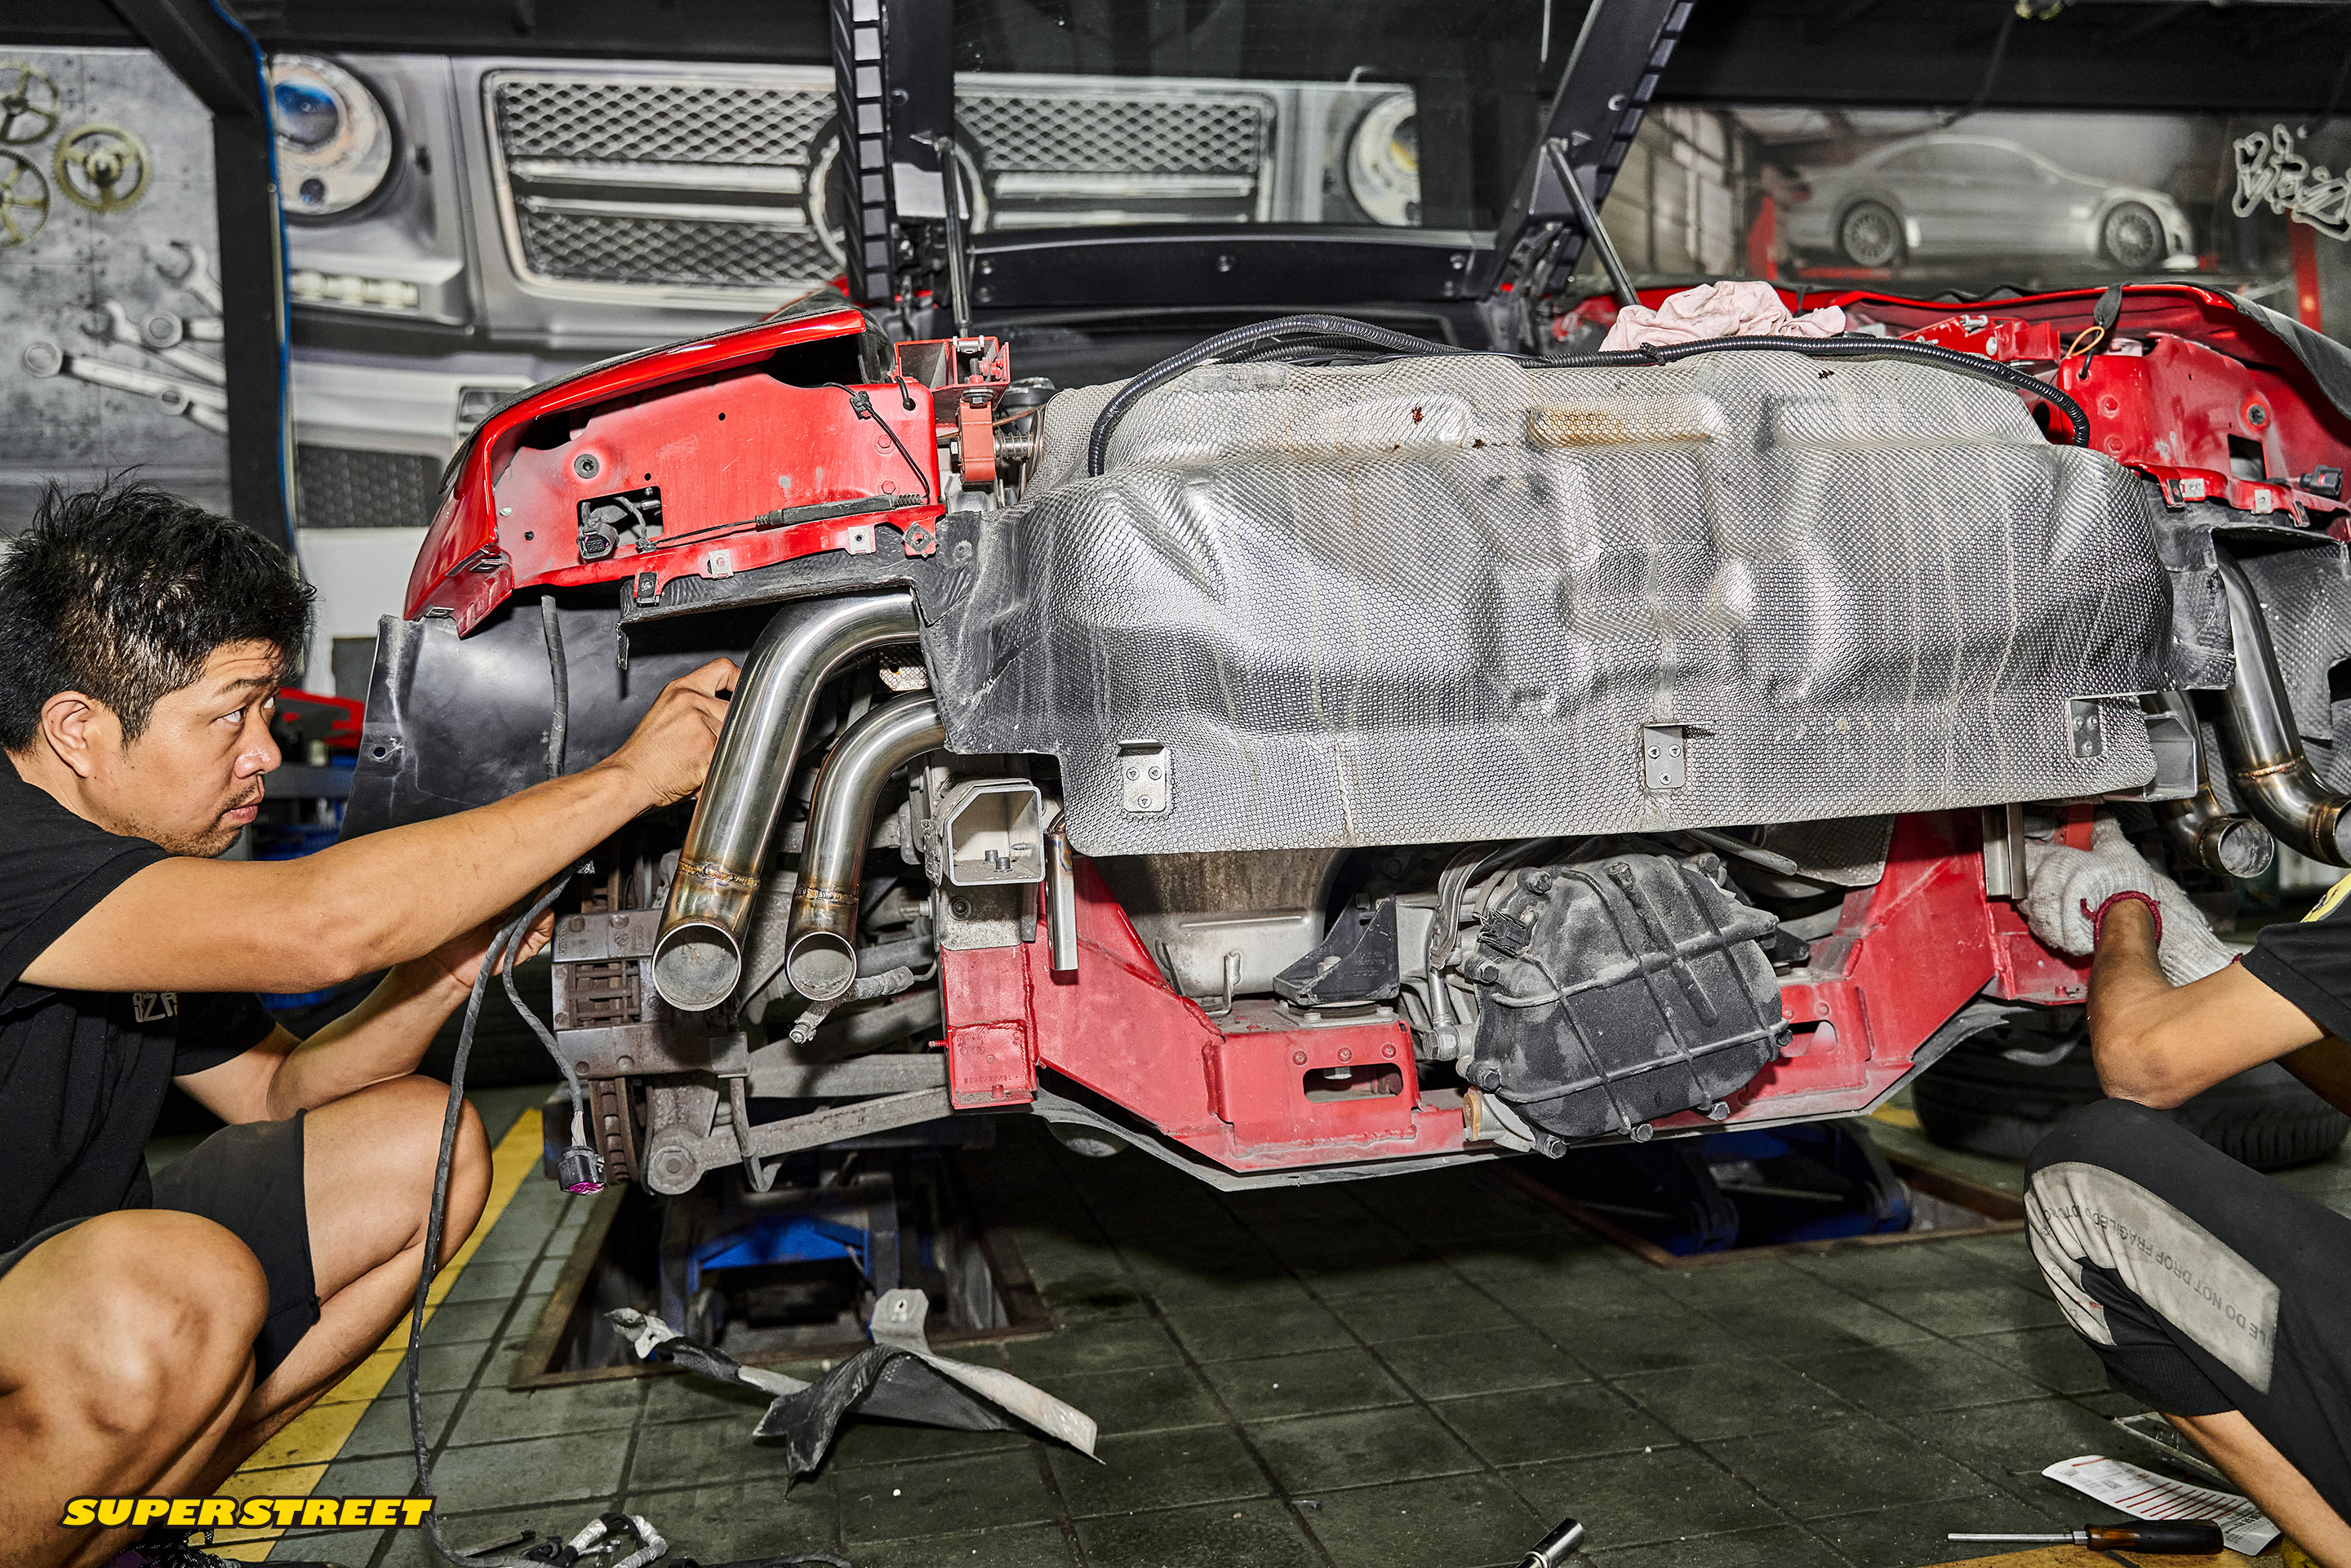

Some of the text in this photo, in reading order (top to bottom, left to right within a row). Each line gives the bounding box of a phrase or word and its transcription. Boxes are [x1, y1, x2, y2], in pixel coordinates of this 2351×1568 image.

[2155, 1252, 2191, 1285] DROP
[2193, 1281, 2222, 1310] NOT
[2225, 1305, 2246, 1329] DO
